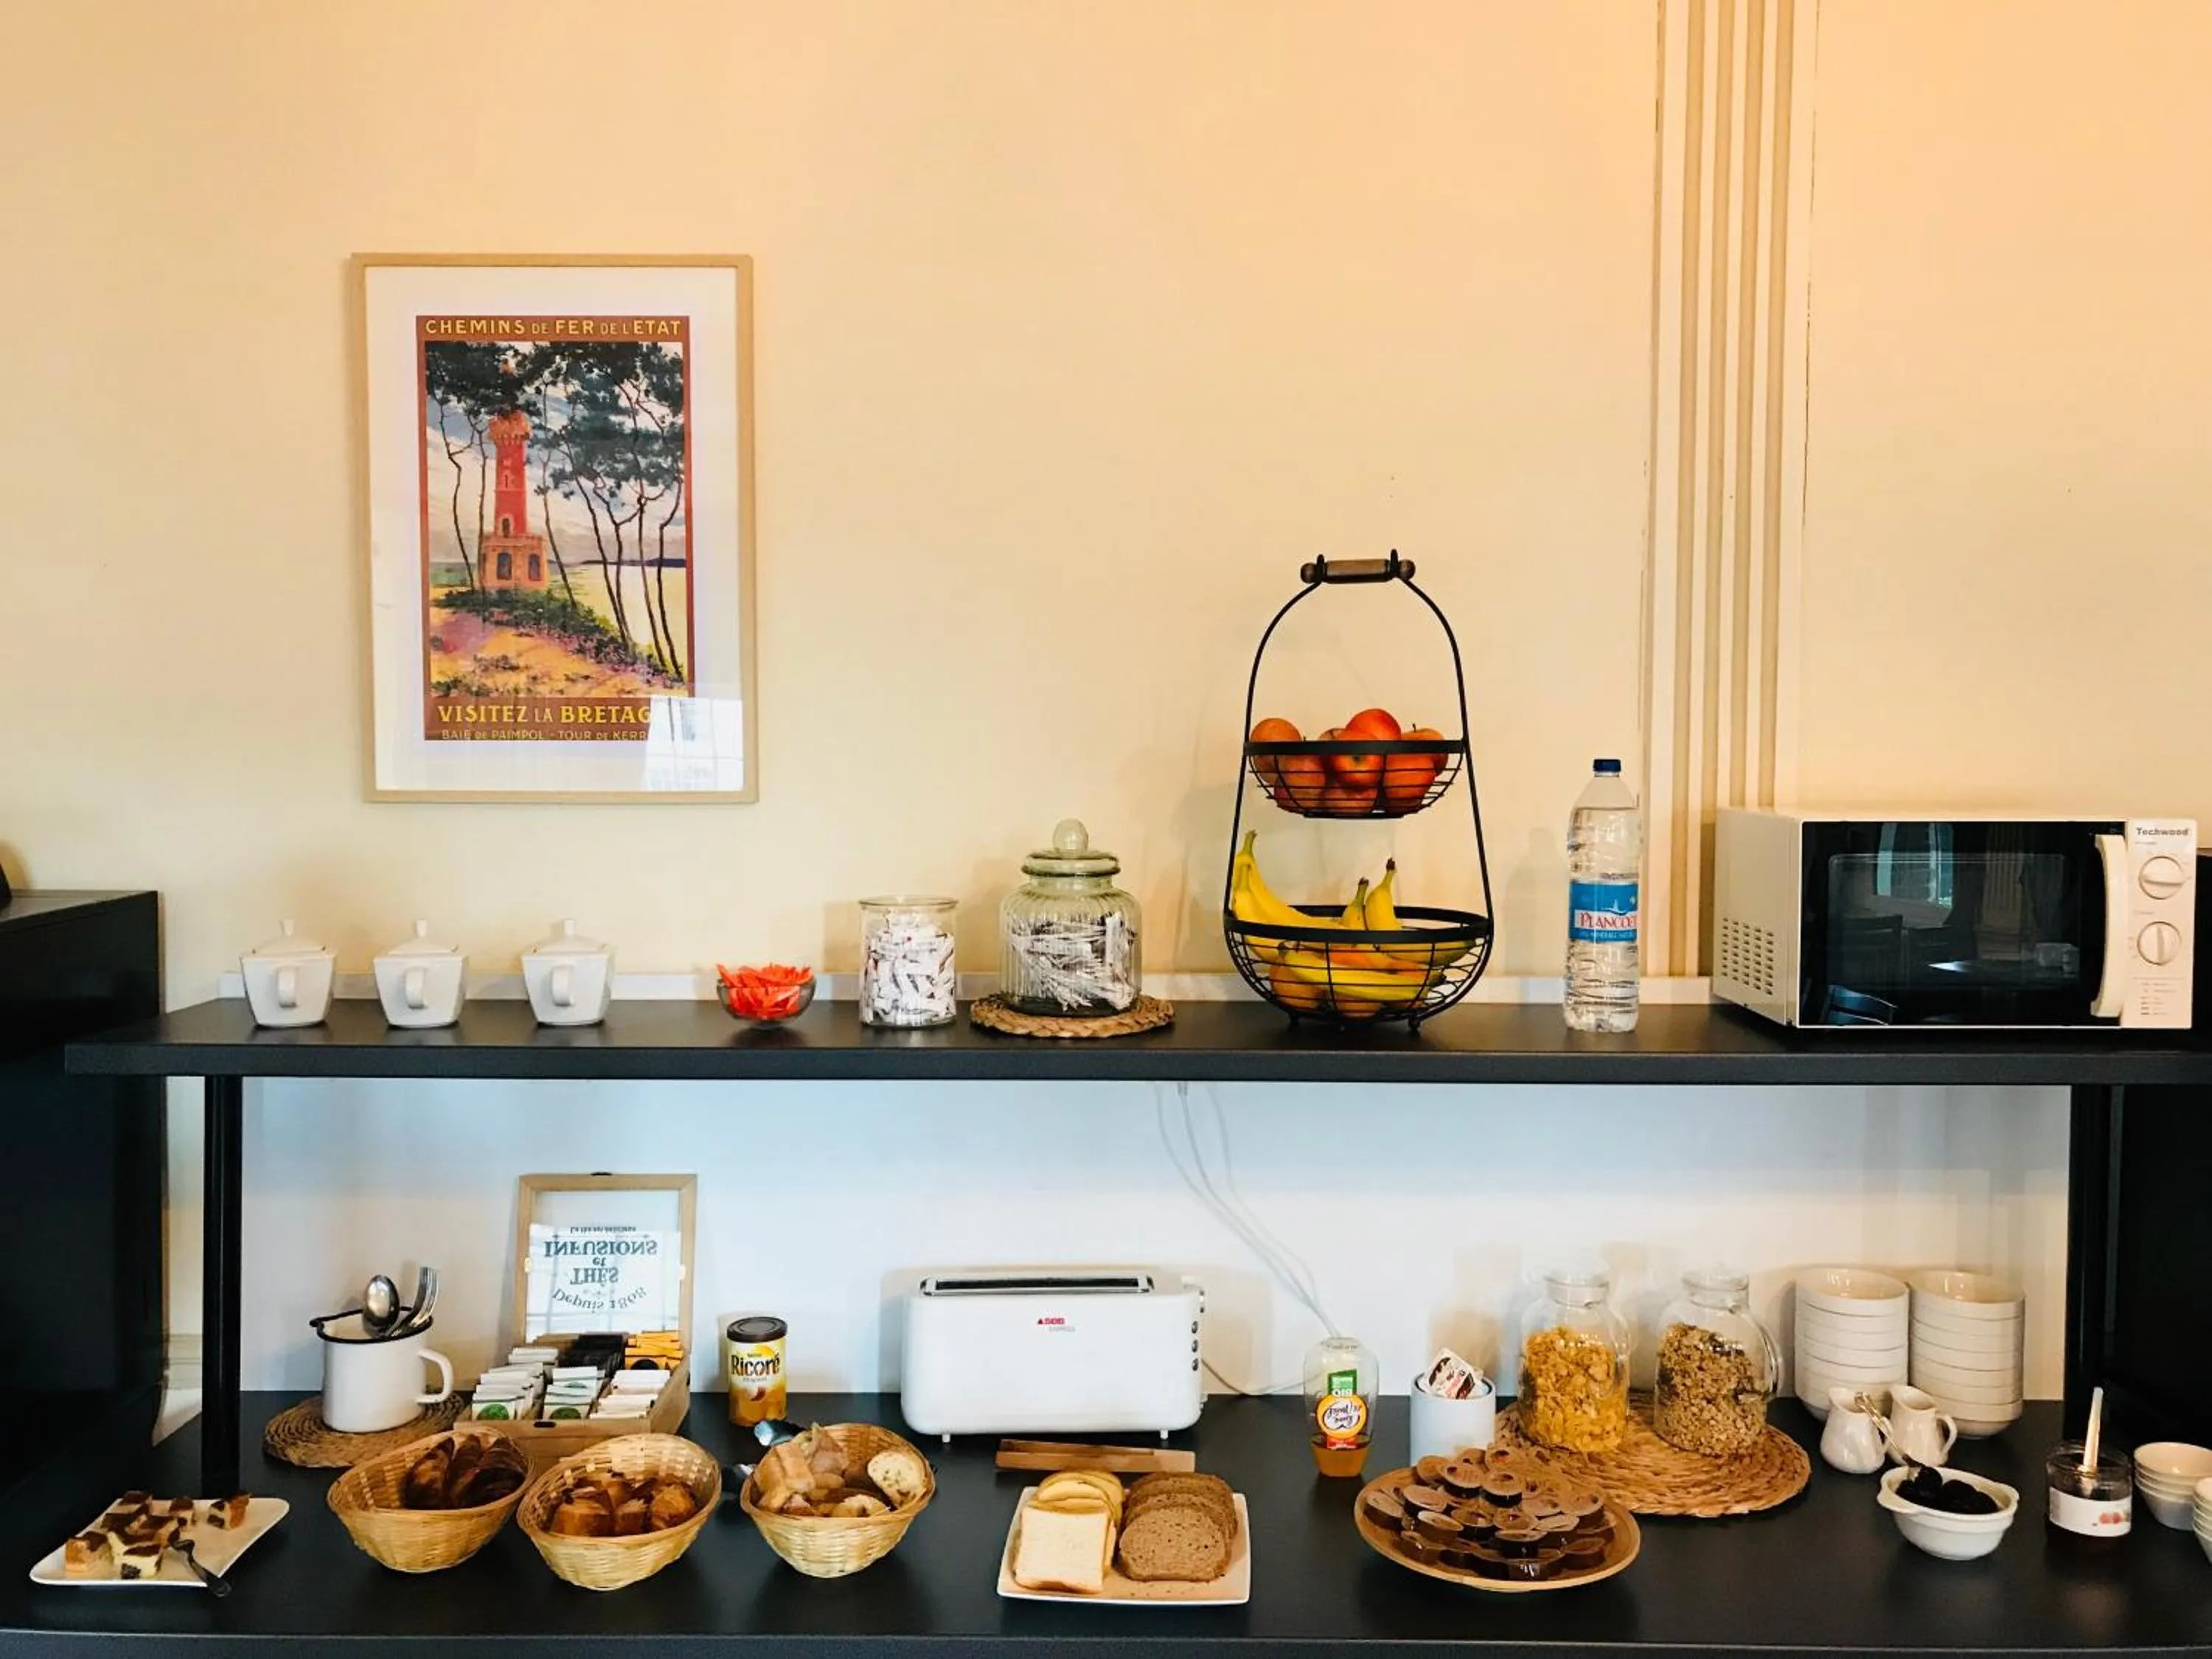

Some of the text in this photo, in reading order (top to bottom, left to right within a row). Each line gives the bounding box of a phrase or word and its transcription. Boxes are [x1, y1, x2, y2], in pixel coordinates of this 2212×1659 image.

[425, 319, 526, 335] CHEMINS
[531, 321, 549, 335] DE
[554, 319, 594, 335] FER
[600, 321, 618, 335] DE
[437, 705, 651, 724] VISITEZ LA BRETAG
[441, 729, 471, 740] BAIE
[491, 730, 544, 741] PAIMPOL
[558, 731, 591, 741] TOUR
[613, 731, 650, 741] KERR
[2136, 827, 2189, 836] Techwood
[731, 1352, 781, 1377] Ricoré
